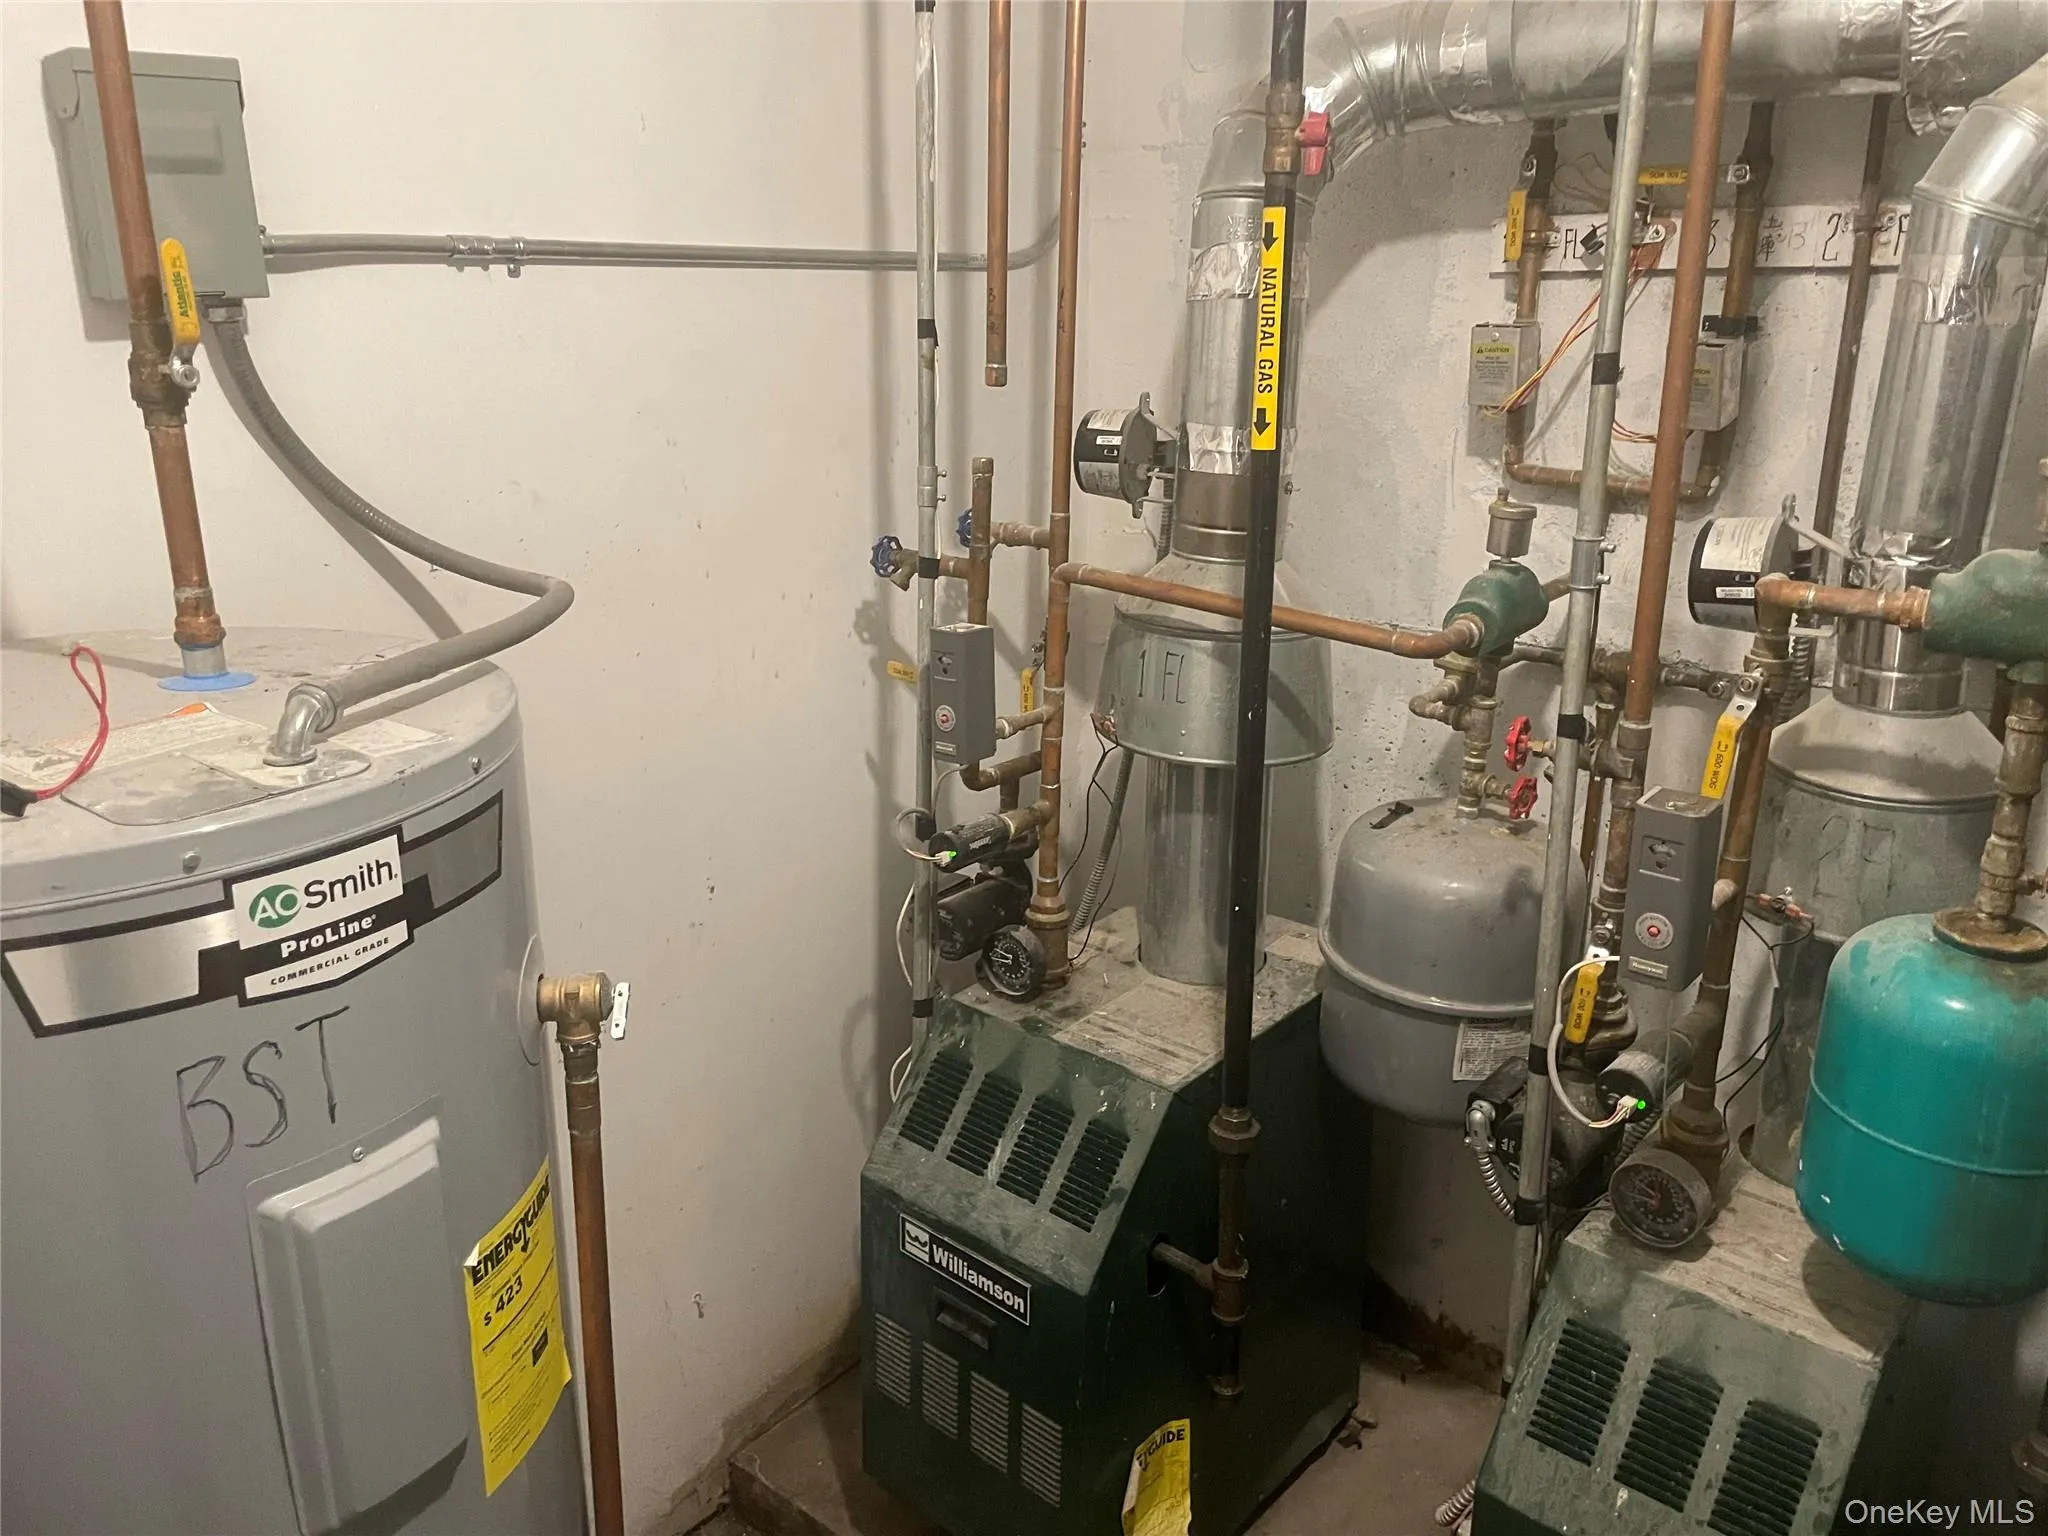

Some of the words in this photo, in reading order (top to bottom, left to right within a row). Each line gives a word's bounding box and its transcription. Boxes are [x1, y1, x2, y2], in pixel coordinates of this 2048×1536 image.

[172, 271, 190, 317] Atlantic
[1259, 268, 1277, 352] NATURAL
[1257, 359, 1274, 393] GAS
[1138, 649, 1147, 698] 1
[1162, 651, 1187, 704] FL
[304, 859, 394, 909] Smith
[270, 953, 350, 986] COMMERCIAL
[354, 936, 390, 956] GRADE
[280, 916, 374, 958] ProLine
[176, 1005, 350, 1182] BST
[932, 1244, 1025, 1314] Williamson
